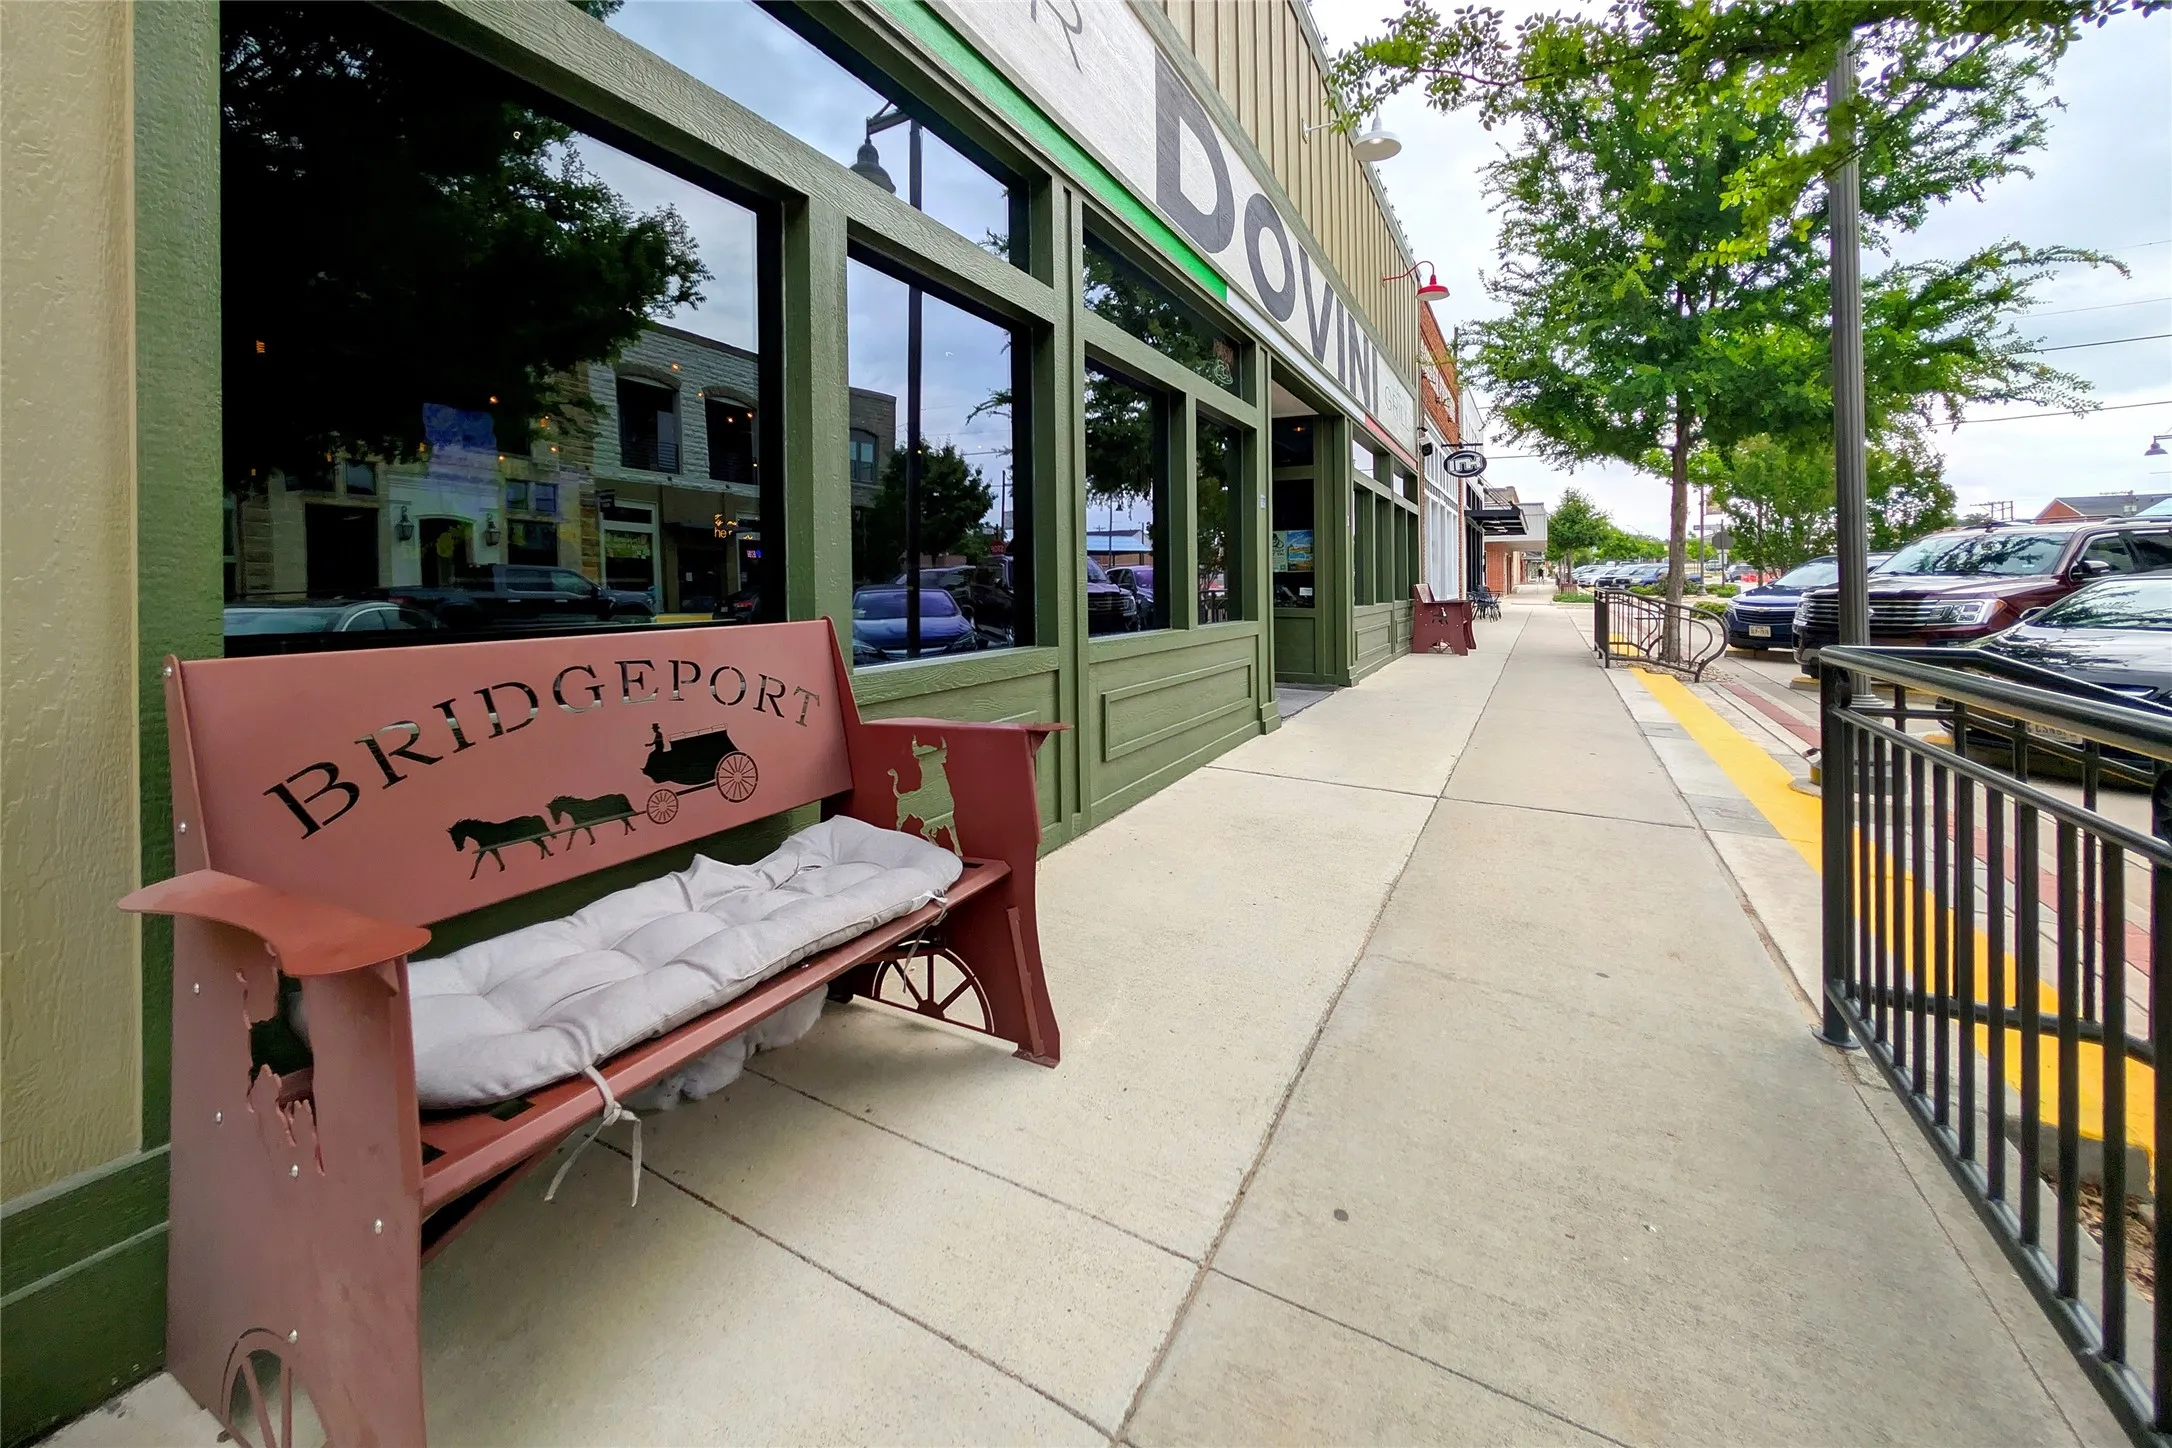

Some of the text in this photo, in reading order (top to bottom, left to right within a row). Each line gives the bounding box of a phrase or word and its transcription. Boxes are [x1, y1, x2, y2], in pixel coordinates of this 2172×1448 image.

[1154, 46, 1410, 432] DOVINI GRILL
[263, 659, 820, 840] BRIDGEPORT
